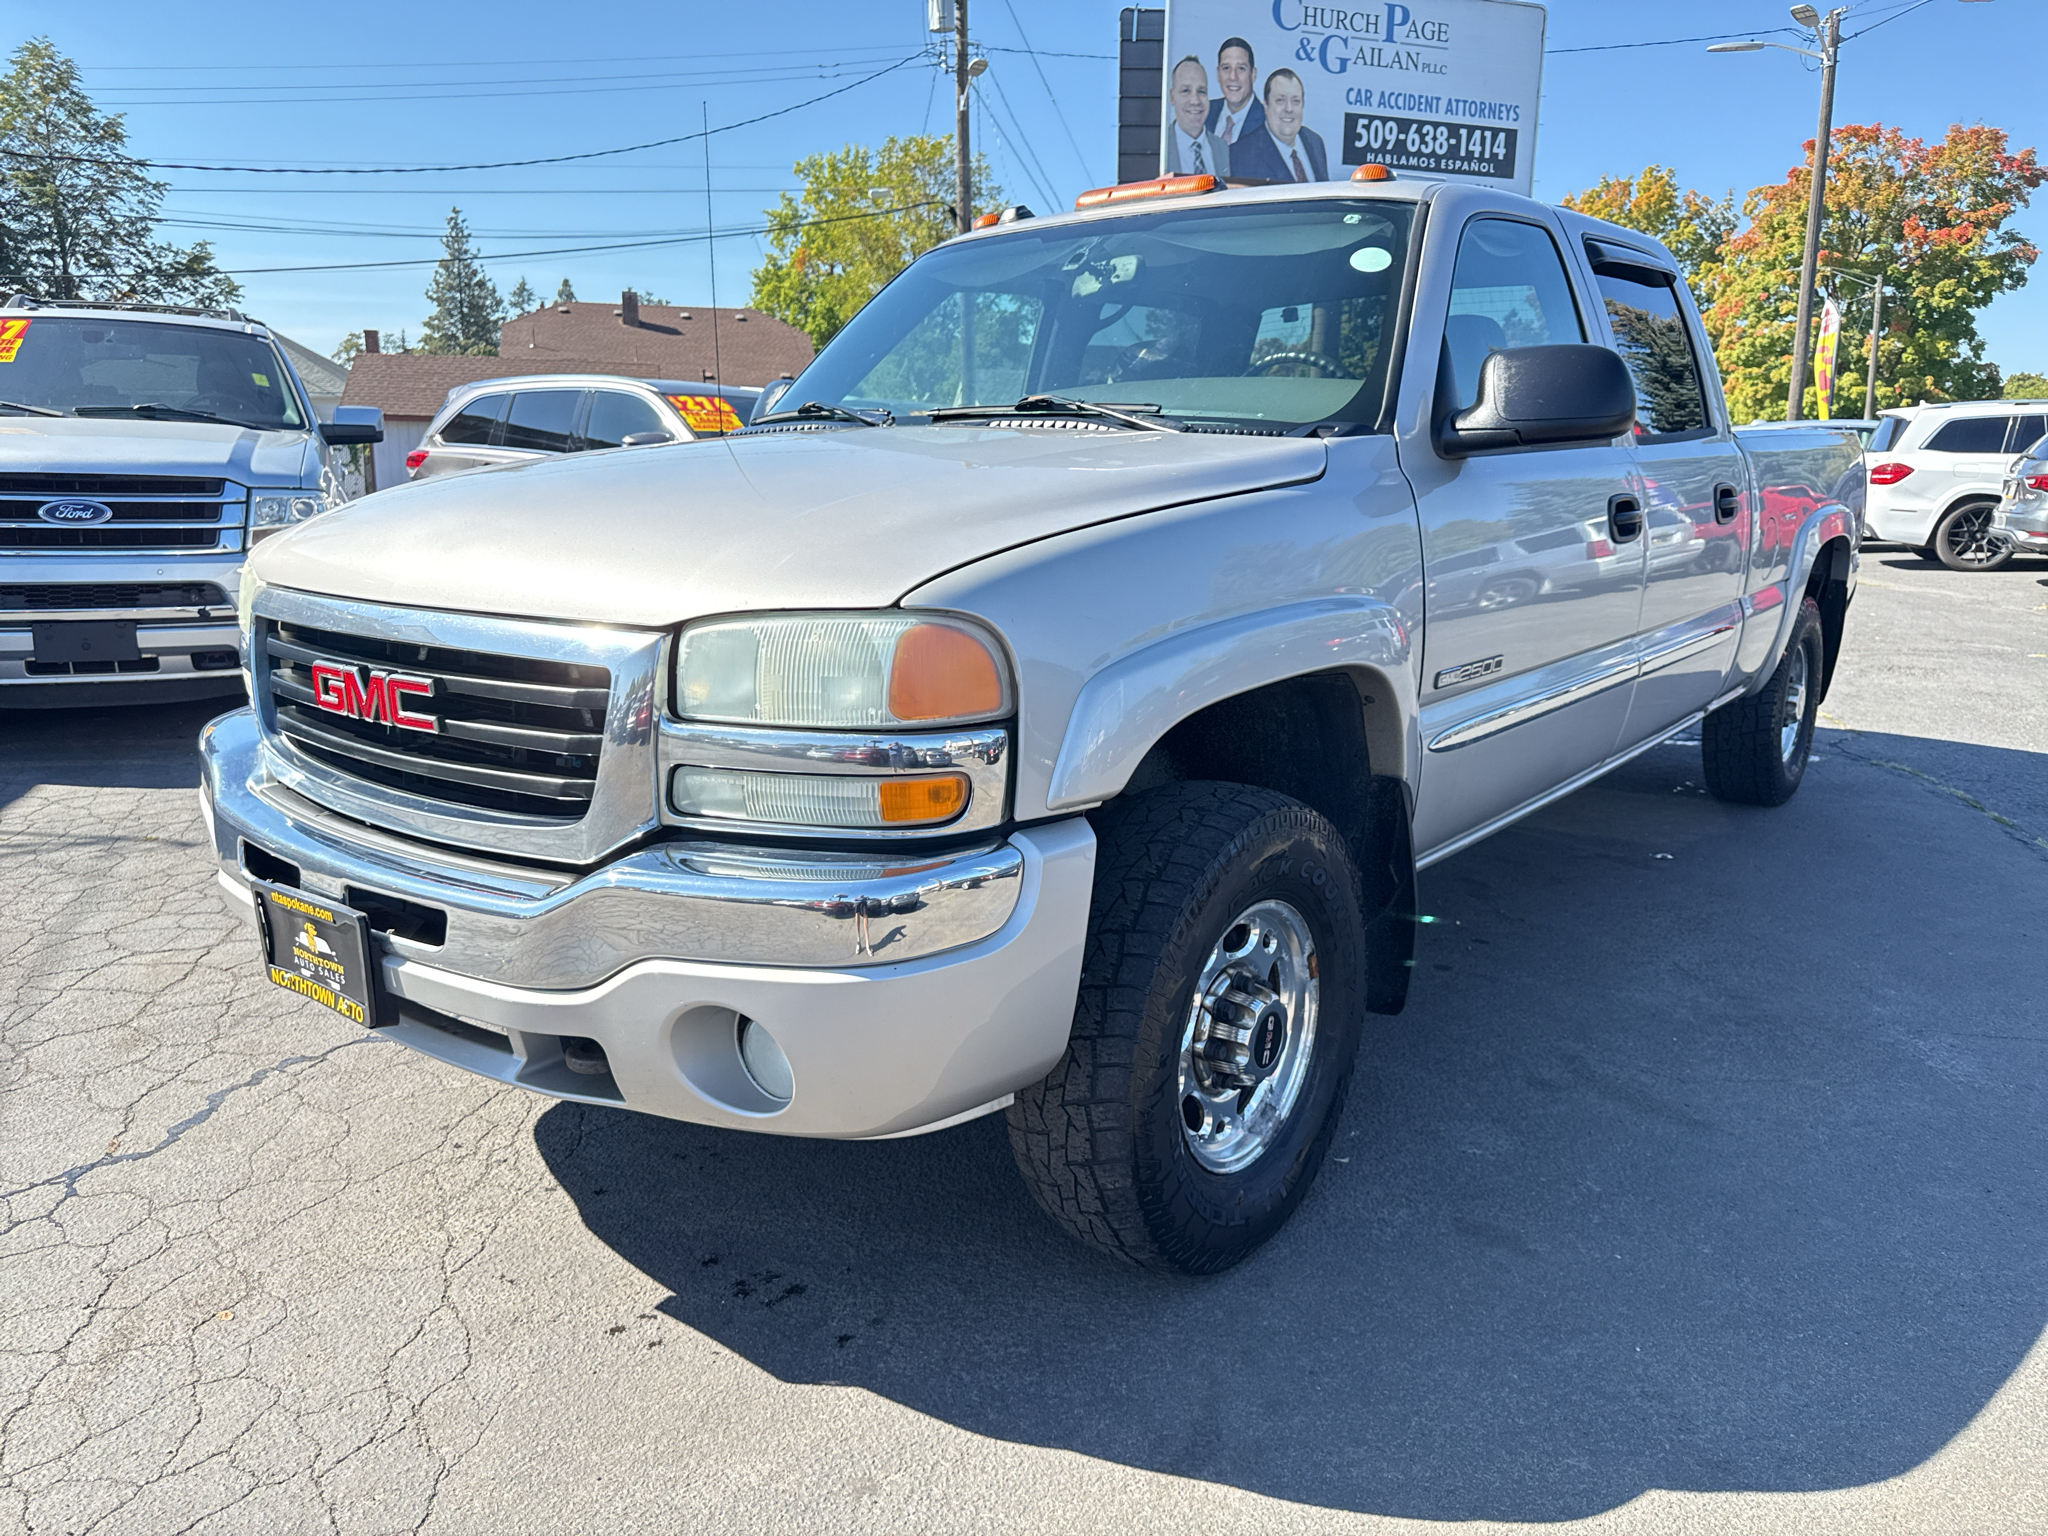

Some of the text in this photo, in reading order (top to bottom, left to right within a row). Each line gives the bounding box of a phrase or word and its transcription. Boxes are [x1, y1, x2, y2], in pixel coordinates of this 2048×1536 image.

[1272, 0, 1449, 43] CHURCH PAGE
[1422, 62, 1448, 75] PLLC
[1346, 87, 1520, 122] CAR ACCIDENT ATTORNEYS
[1354, 118, 1507, 160] 509-638-1414
[1366, 152, 1496, 173] HABLAMOS ESPAÑOL
[55, 504, 94, 519] Ford
[312, 660, 439, 734] GMC
[271, 891, 333, 922] ntaspokane.com
[293, 946, 345, 975] NORTHTOWN
[294, 956, 346, 985] AUTO SALES
[270, 967, 364, 1023] NORTHTOWN AUTO
[1262, 1015, 1275, 1065] GMC
